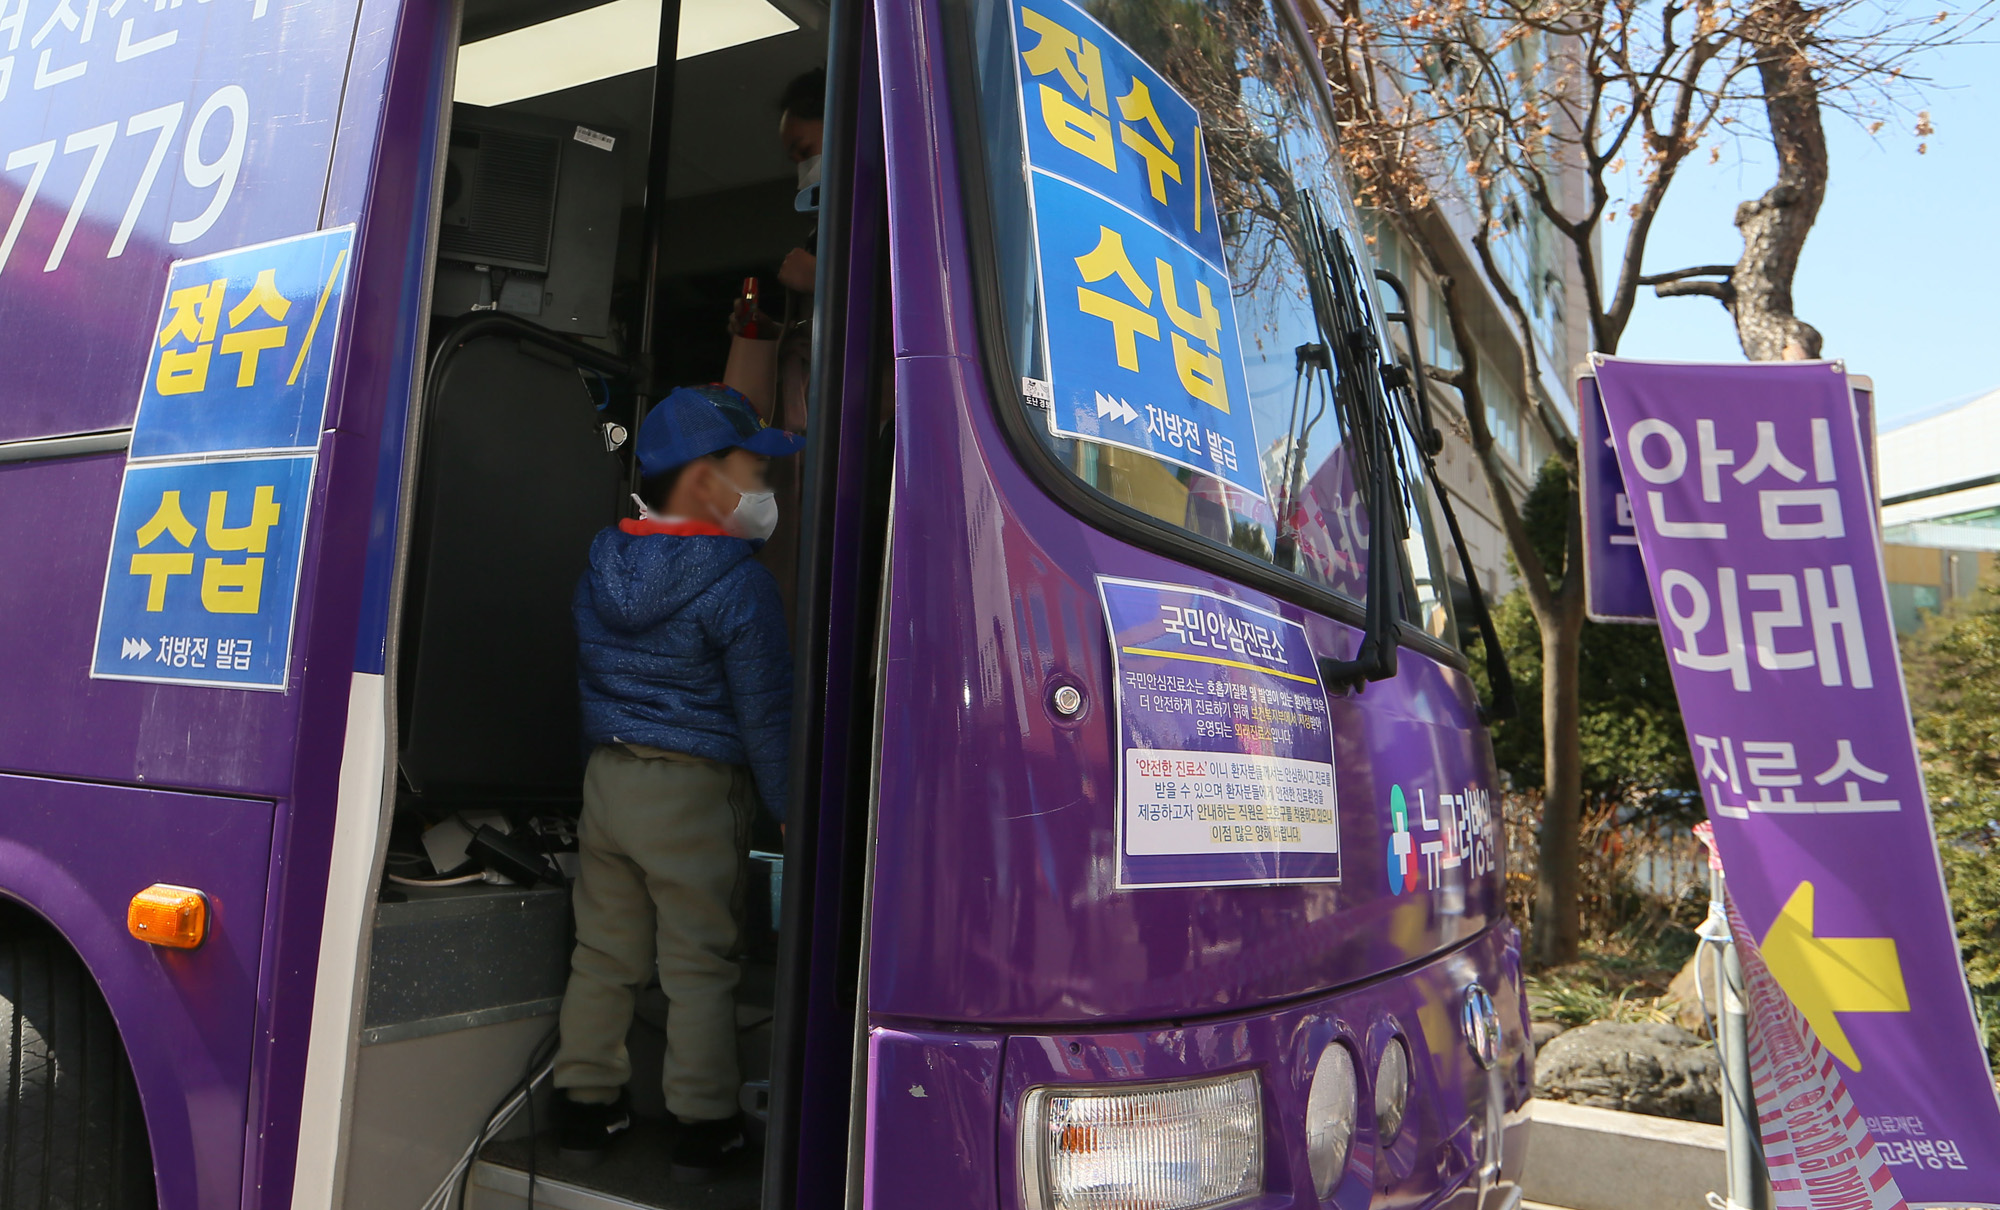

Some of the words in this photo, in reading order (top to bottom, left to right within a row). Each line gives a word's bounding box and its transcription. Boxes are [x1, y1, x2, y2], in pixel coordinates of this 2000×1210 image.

[1074, 224, 1231, 416] 수납
[1145, 403, 1202, 456] 처방전
[1205, 428, 1239, 473] 발급
[1627, 417, 1845, 540] 안심
[129, 485, 281, 614] 수납
[1160, 604, 1289, 665] 국민안심진료소
[1660, 564, 1873, 692] 외래
[155, 635, 209, 668] 처방전
[216, 638, 253, 671] 발급
[1126, 671, 1205, 695] 국민안심진료소는
[1206, 680, 1248, 701] 호흡기질환
[1249, 686, 1258, 702] 및
[1280, 691, 1294, 708] 있는
[1139, 694, 1151, 712] 더
[1153, 695, 1193, 715] 안전하게
[1195, 699, 1232, 718] 진료하기
[1233, 703, 1250, 720] 위해
[1196, 719, 1233, 738] 운영되는
[1155, 781, 1176, 799] 받을
[1180, 782, 1190, 799] 수
[1194, 782, 1223, 800] 있으며
[1275, 785, 1296, 802] 안전한
[1297, 787, 1324, 805] 진료환경을
[1694, 733, 1901, 820] 진료소
[1138, 804, 1193, 821] 제공하고자
[1197, 804, 1236, 821] 안내하는
[1239, 804, 1264, 821] 직원은
[1212, 825, 1232, 842] 이점
[1235, 825, 1253, 842] 많은
[1255, 825, 1273, 842] 양해
